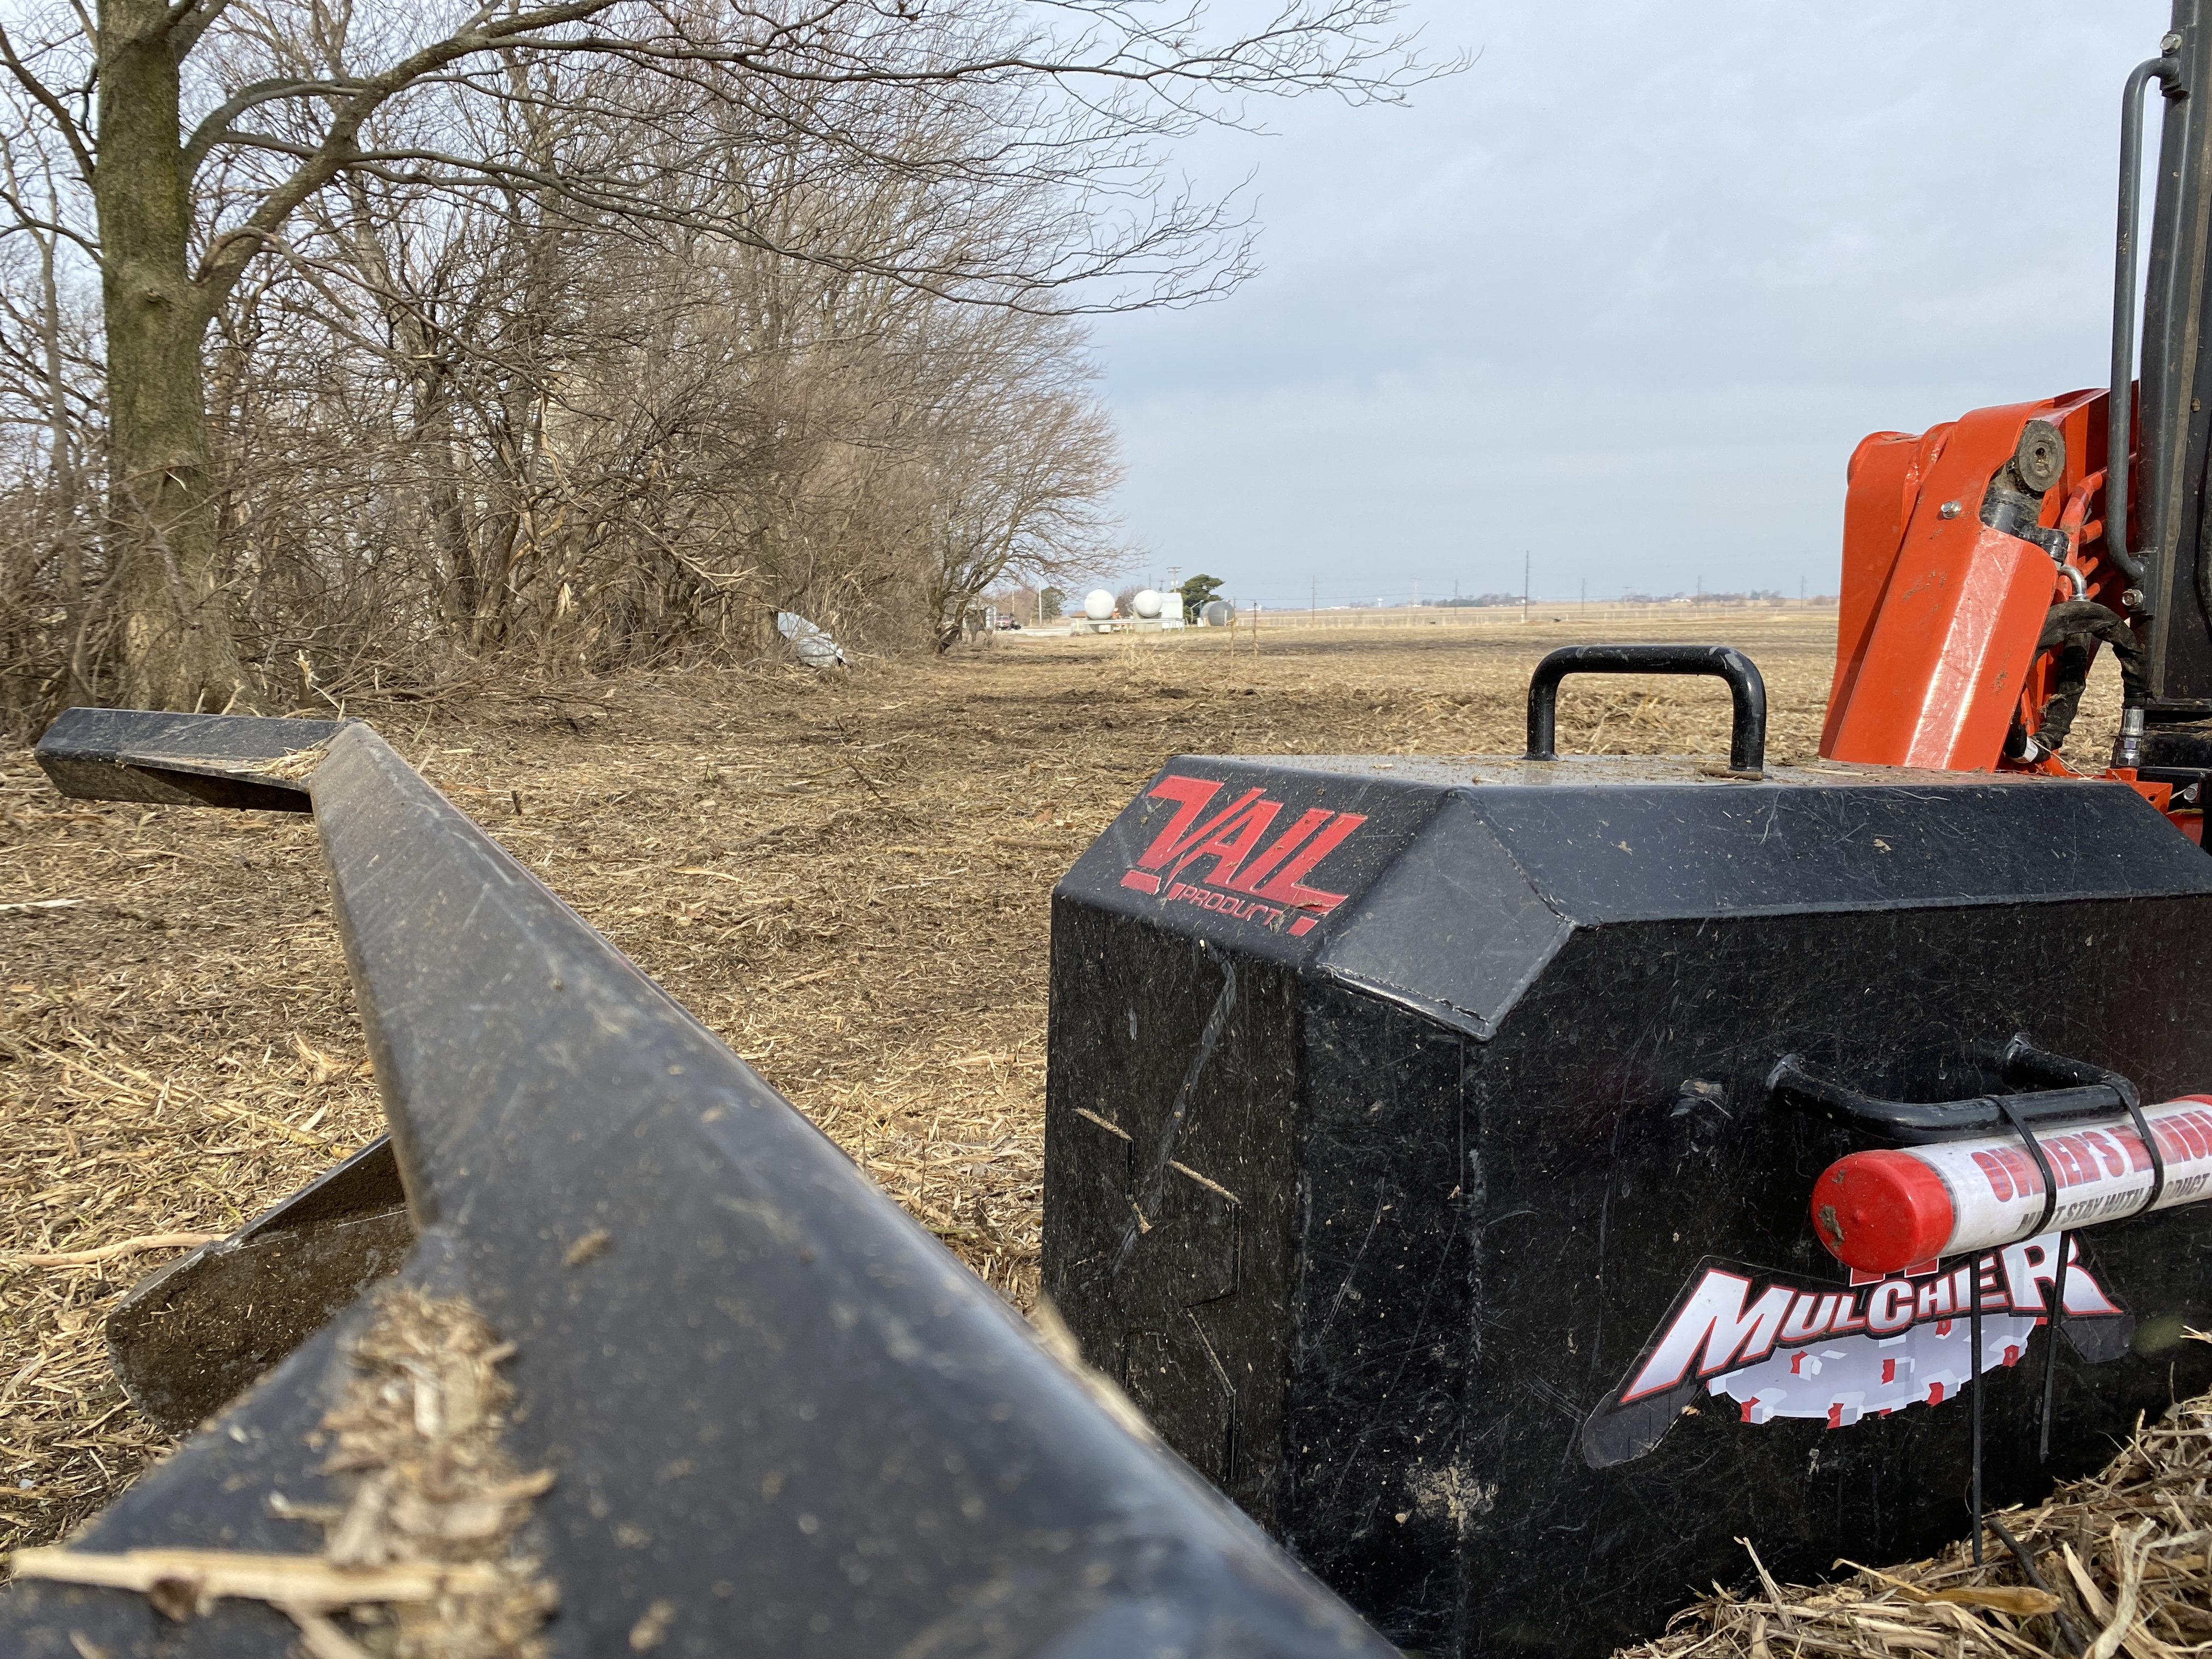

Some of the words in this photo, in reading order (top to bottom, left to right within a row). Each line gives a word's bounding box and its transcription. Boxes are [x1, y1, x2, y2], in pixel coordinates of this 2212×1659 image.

[1136, 775, 1368, 914] VAIL
[2103, 1110, 2212, 1172] MANUA
[2014, 1205, 2067, 1235] MT
[2060, 1196, 2105, 1224] STAY
[2098, 1187, 2145, 1216] WITH
[2138, 1172, 2210, 1208] ODUCT
